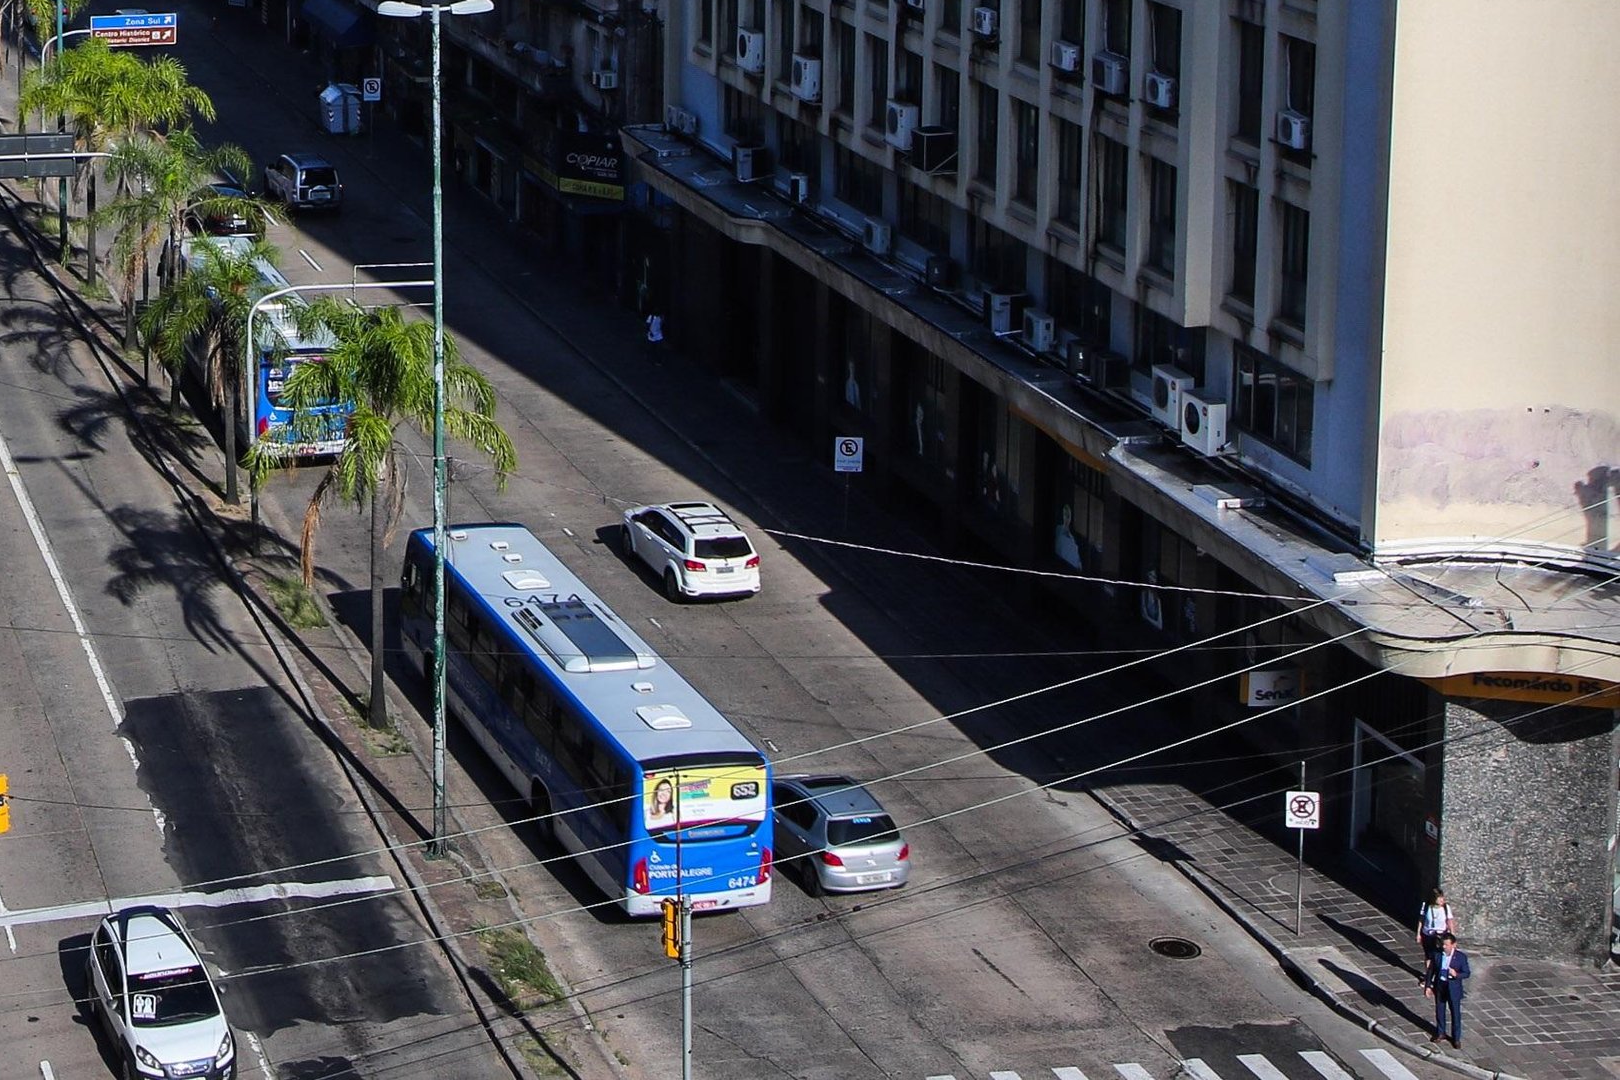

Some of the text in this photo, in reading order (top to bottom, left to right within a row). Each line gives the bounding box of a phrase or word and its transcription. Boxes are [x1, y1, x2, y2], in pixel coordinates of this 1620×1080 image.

[566, 152, 618, 168] COPIAR
[733, 783, 756, 797] 652
[681, 867, 713, 877] ALEGRE
[728, 876, 757, 888] 6474
